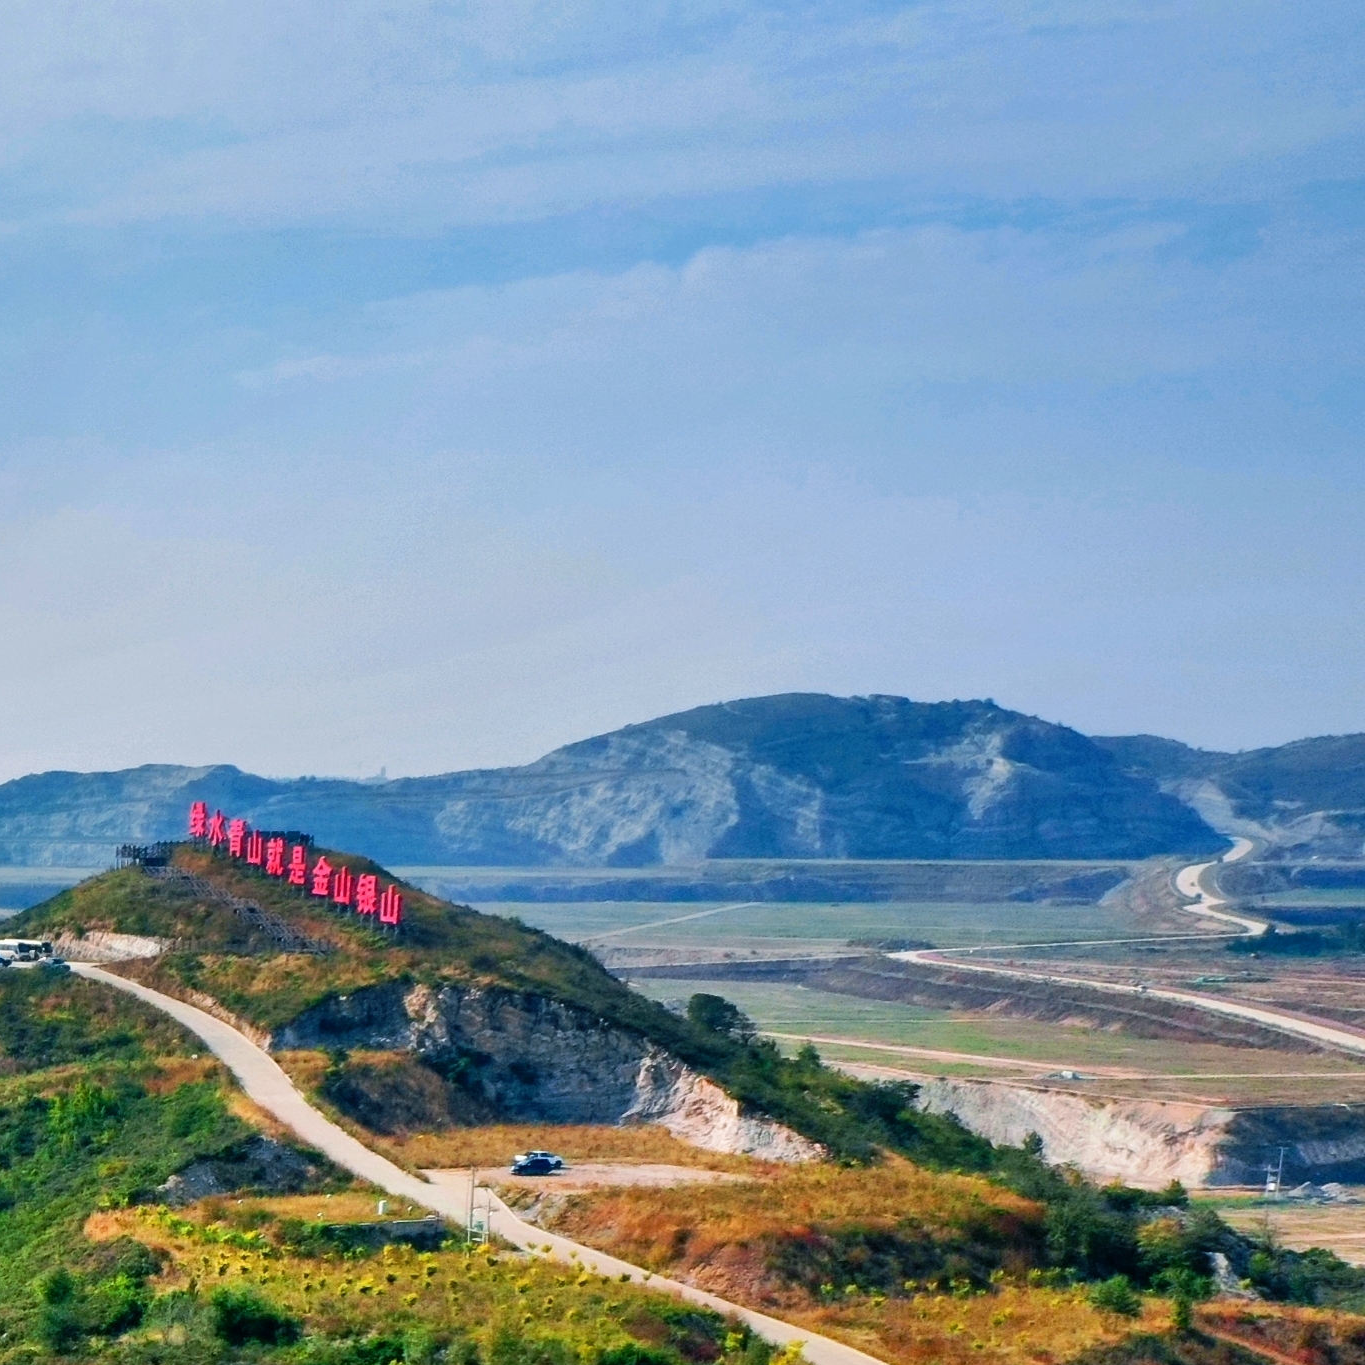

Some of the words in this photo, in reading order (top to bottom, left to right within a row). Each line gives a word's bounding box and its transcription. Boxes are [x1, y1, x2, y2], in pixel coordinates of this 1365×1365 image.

[188, 801, 402, 925] 绿水青山就是金山银山
